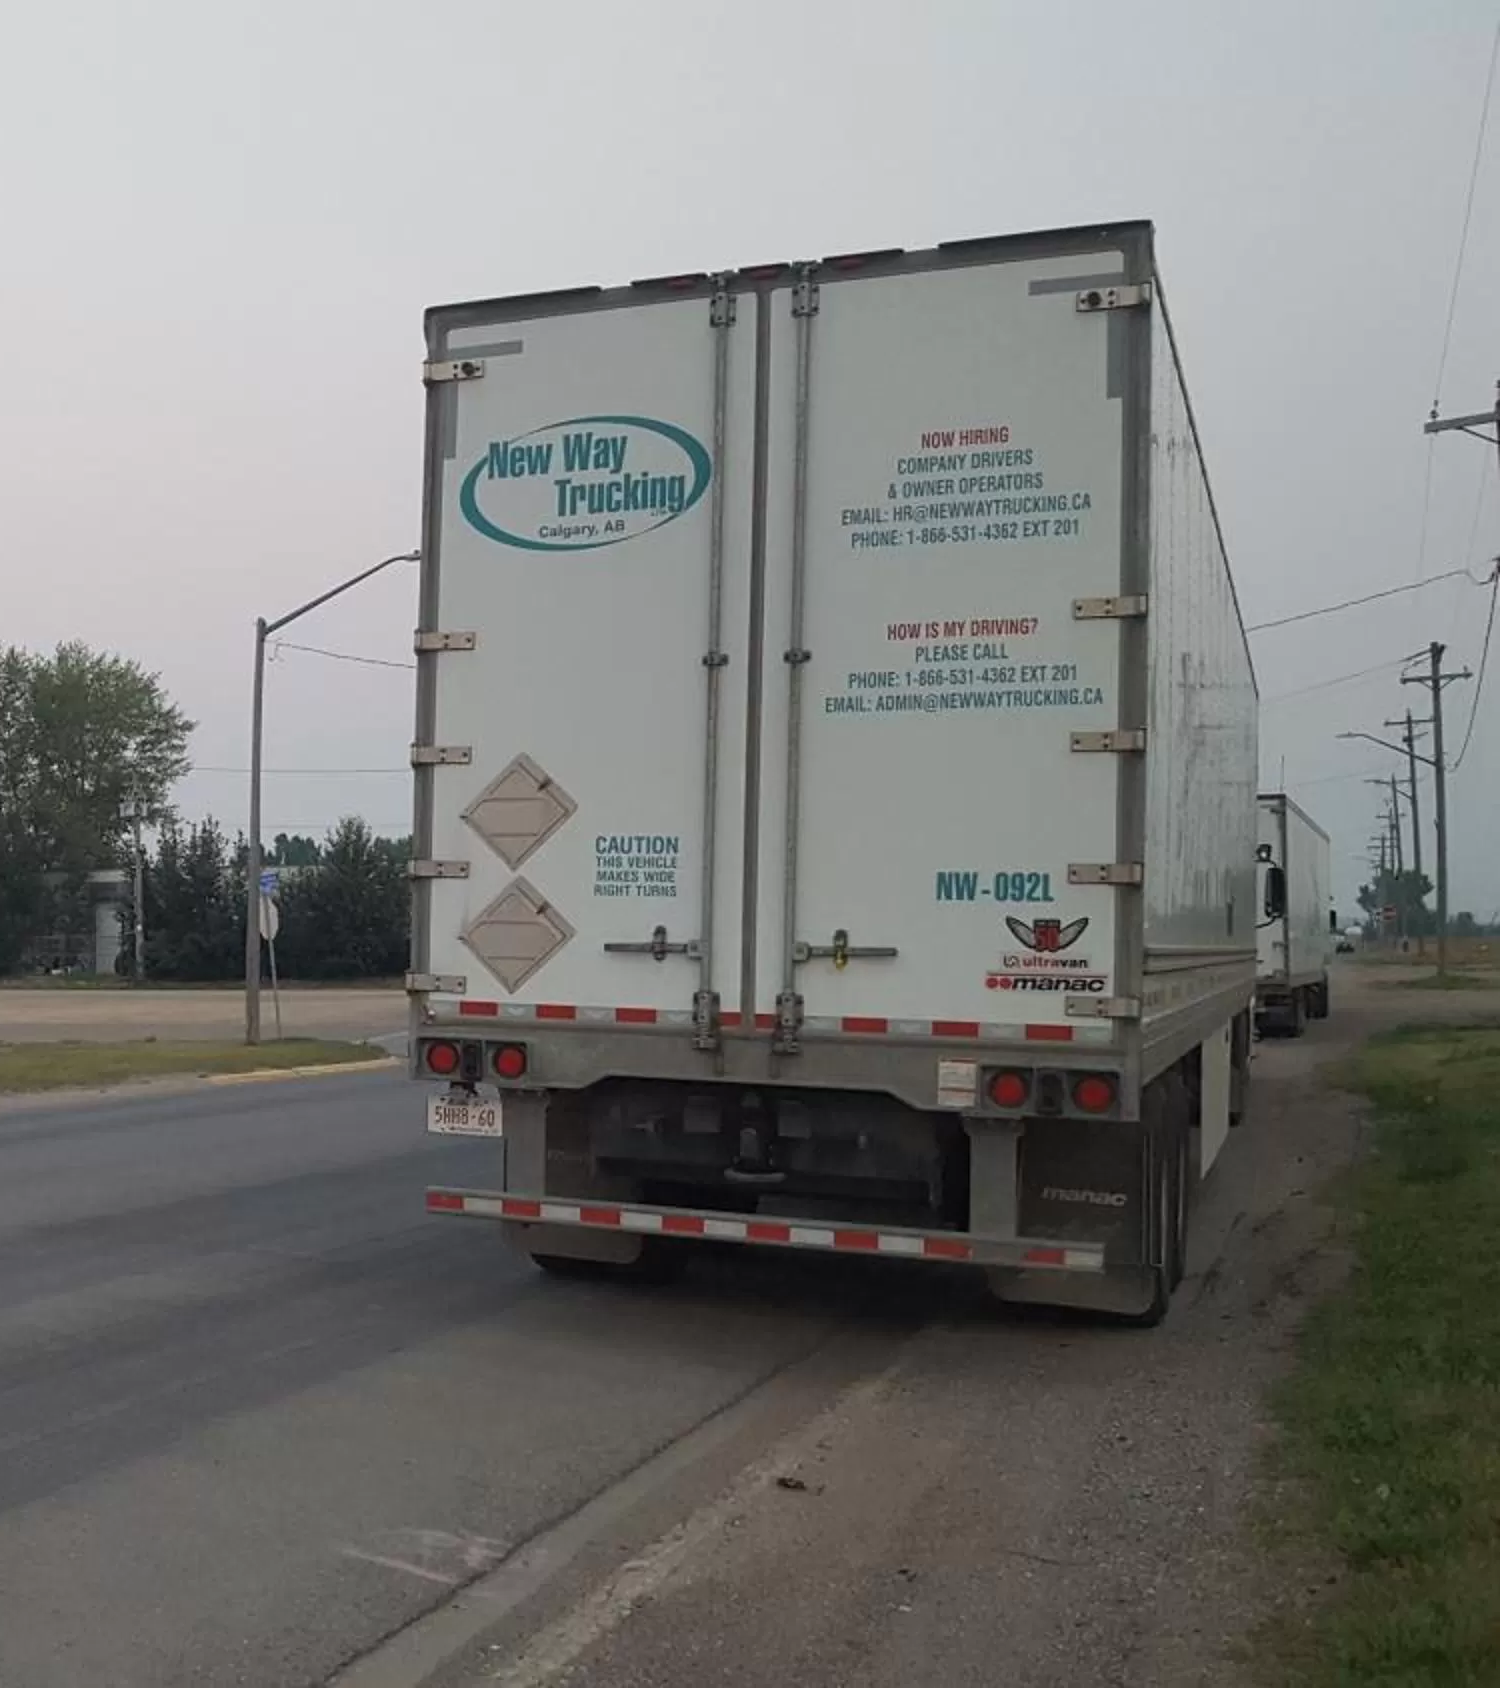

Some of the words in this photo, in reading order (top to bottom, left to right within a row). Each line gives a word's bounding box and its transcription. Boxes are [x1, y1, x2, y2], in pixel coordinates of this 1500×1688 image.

[921, 431, 955, 449] NOW
[959, 426, 1009, 446] HIRING
[487, 440, 553, 480] New
[562, 431, 628, 475] Way
[898, 453, 967, 475] COMPANY
[971, 449, 1033, 469] DRIVERS
[554, 471, 687, 517] Trucking
[888, 483, 897, 499] &
[903, 478, 954, 498] OWNER
[959, 472, 1043, 495] OPERATORS
[841, 507, 889, 526] EMAIL:
[893, 492, 1092, 523] HR@NEWWAYTRUCKING.CA
[539, 523, 599, 539] Calgary,
[603, 519, 625, 533] AB
[851, 529, 903, 549] PHONE:
[906, 522, 1018, 545] 1-866-531-4362
[1023, 520, 1051, 537] EXT
[1053, 518, 1080, 535] 201
[887, 623, 921, 641] HOW
[925, 622, 939, 638] IS
[943, 620, 965, 637] MY
[971, 617, 1039, 637] DRIVING?
[915, 644, 968, 663] PLEASE
[973, 642, 1009, 660] CALL
[849, 671, 900, 689] PHONE:
[905, 666, 1016, 687] 1-866-531-4362
[1021, 665, 1047, 682] EXT
[1051, 664, 1077, 681] 201
[825, 696, 873, 713] EMAIL:
[875, 687, 1104, 713] ADMIN@NEWWAYTRUCKING.CA
[595, 836, 679, 855] CAUTION
[595, 856, 623, 869] THIS
[628, 856, 677, 869] VEHICLE
[596, 870, 640, 883] MAKES
[643, 870, 675, 883] WIDE
[936, 871, 1055, 902] NW-092L
[594, 885, 633, 897] RIGHT
[636, 885, 677, 897] TURNS
[1023, 955, 1089, 968] ultravan
[1012, 978, 1105, 992] manac
[1040, 1187, 1128, 1207] manac
